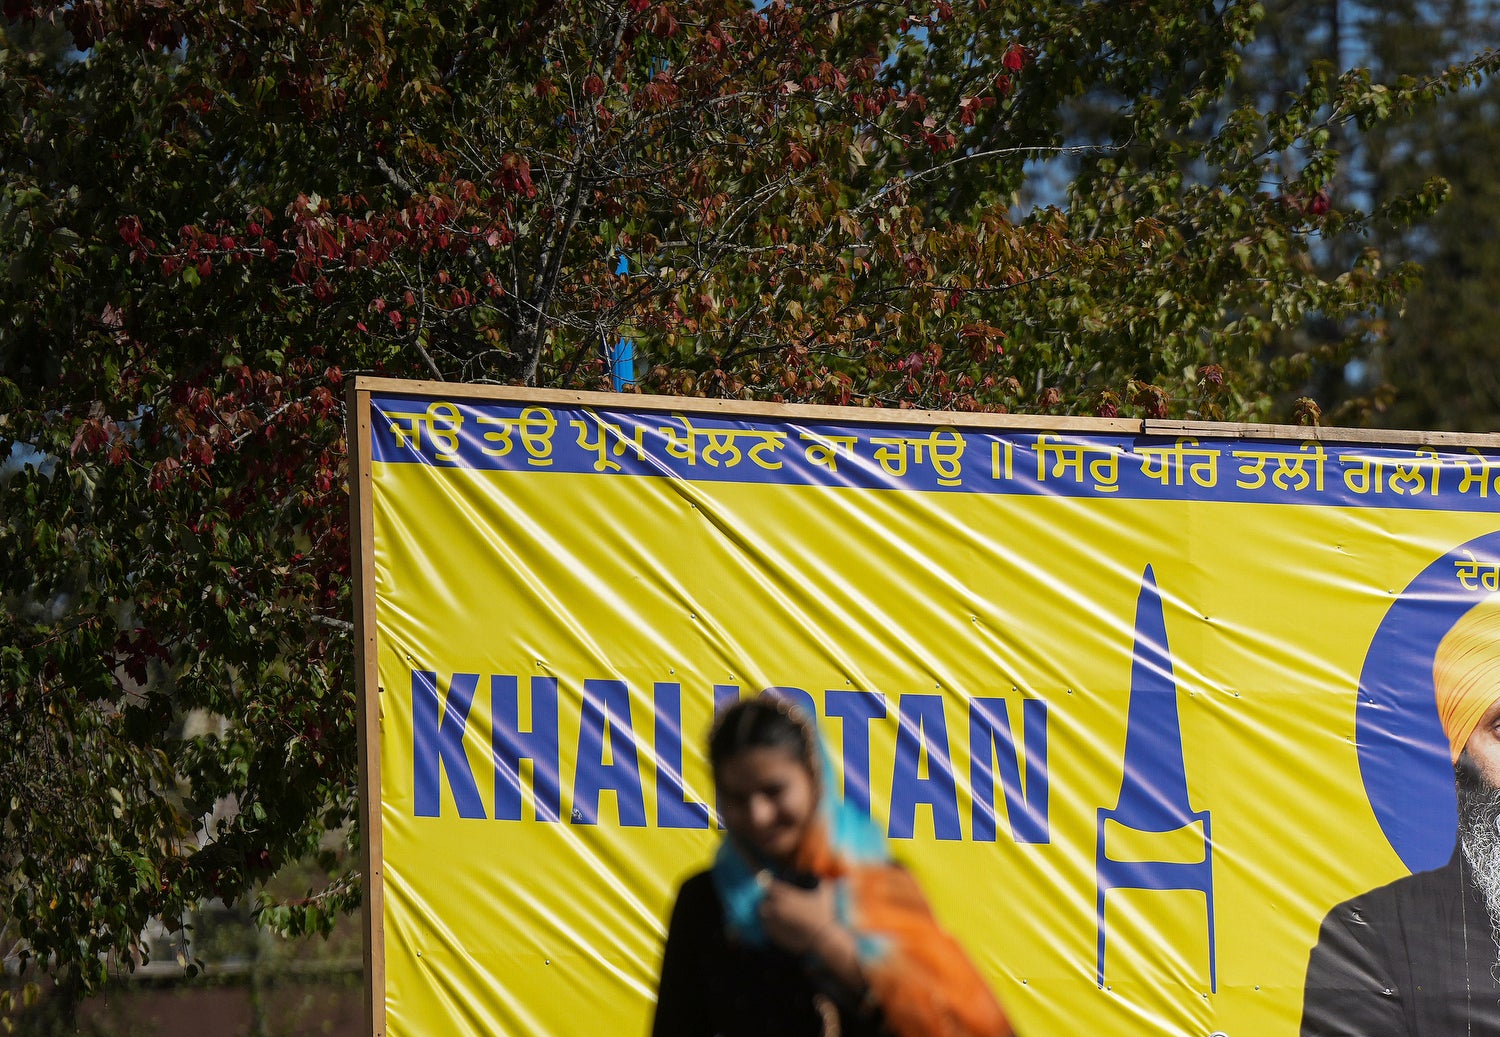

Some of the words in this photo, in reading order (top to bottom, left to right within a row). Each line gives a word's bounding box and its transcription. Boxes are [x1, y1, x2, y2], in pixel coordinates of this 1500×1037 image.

[383, 401, 464, 461] ਜਉ
[477, 405, 557, 466] ਤਉ
[659, 412, 787, 469] ਖੇਲਣ
[800, 432, 858, 472] ਕਾ
[870, 426, 966, 486] ਚਾਉ
[1031, 431, 1125, 492] ਸਿਰੁ
[1134, 436, 1220, 487] ਧਰਿ
[1232, 440, 1328, 491] ਤਲੀ
[1339, 446, 1443, 496] ਗਲੀ
[411, 670, 1050, 844] KHALTAN
